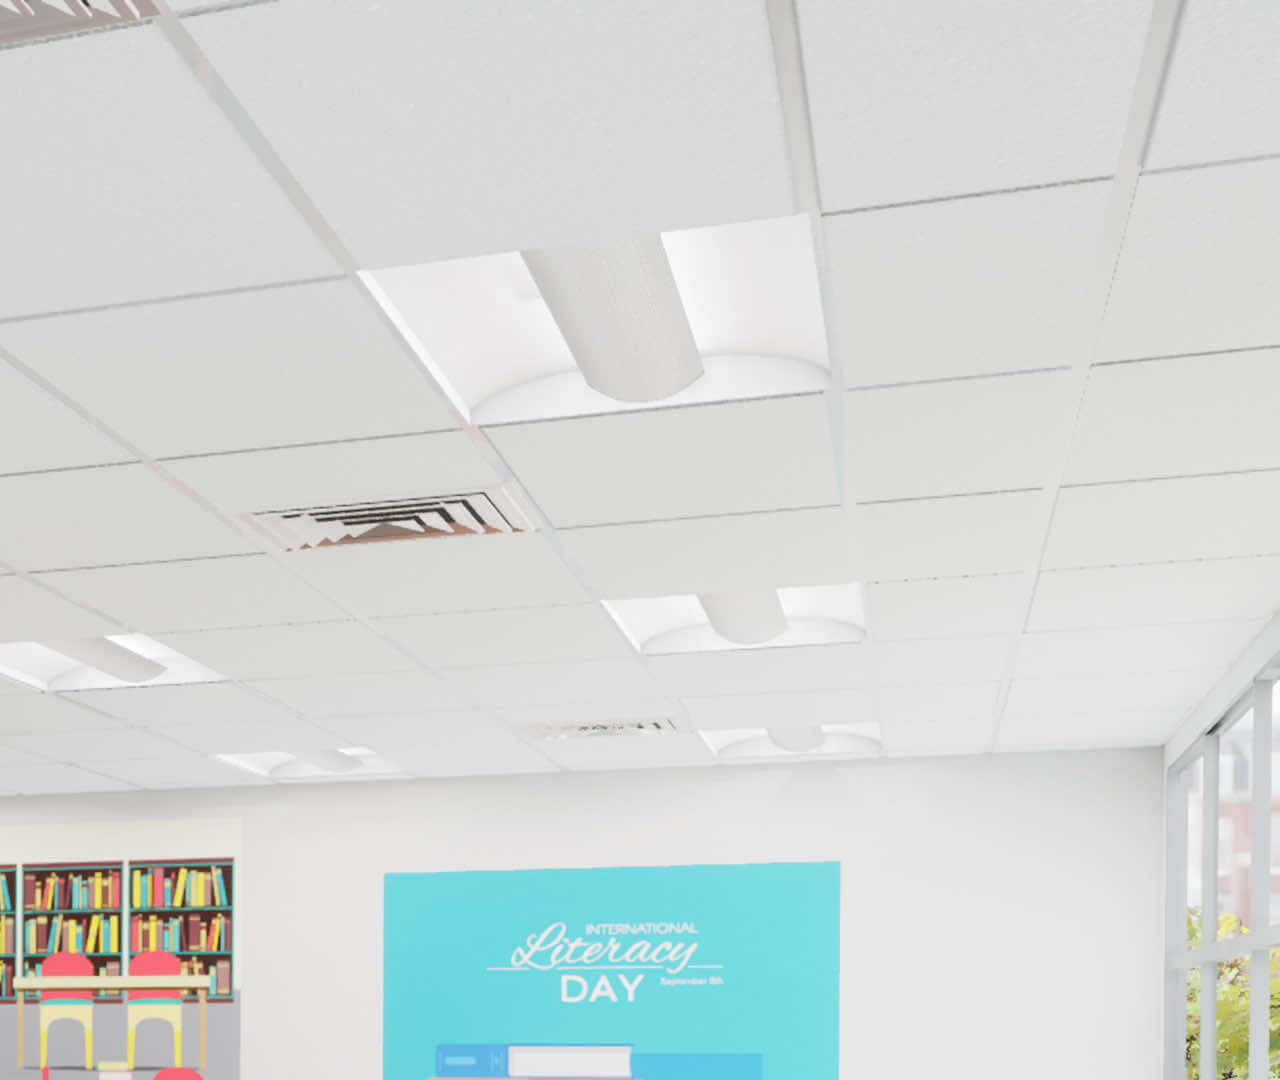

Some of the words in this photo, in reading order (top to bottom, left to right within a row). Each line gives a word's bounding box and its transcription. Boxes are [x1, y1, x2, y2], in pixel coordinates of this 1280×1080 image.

[585, 922, 699, 935] INTERNATIONAL
[511, 921, 699, 974] Literacy
[560, 974, 645, 1002] DAY
